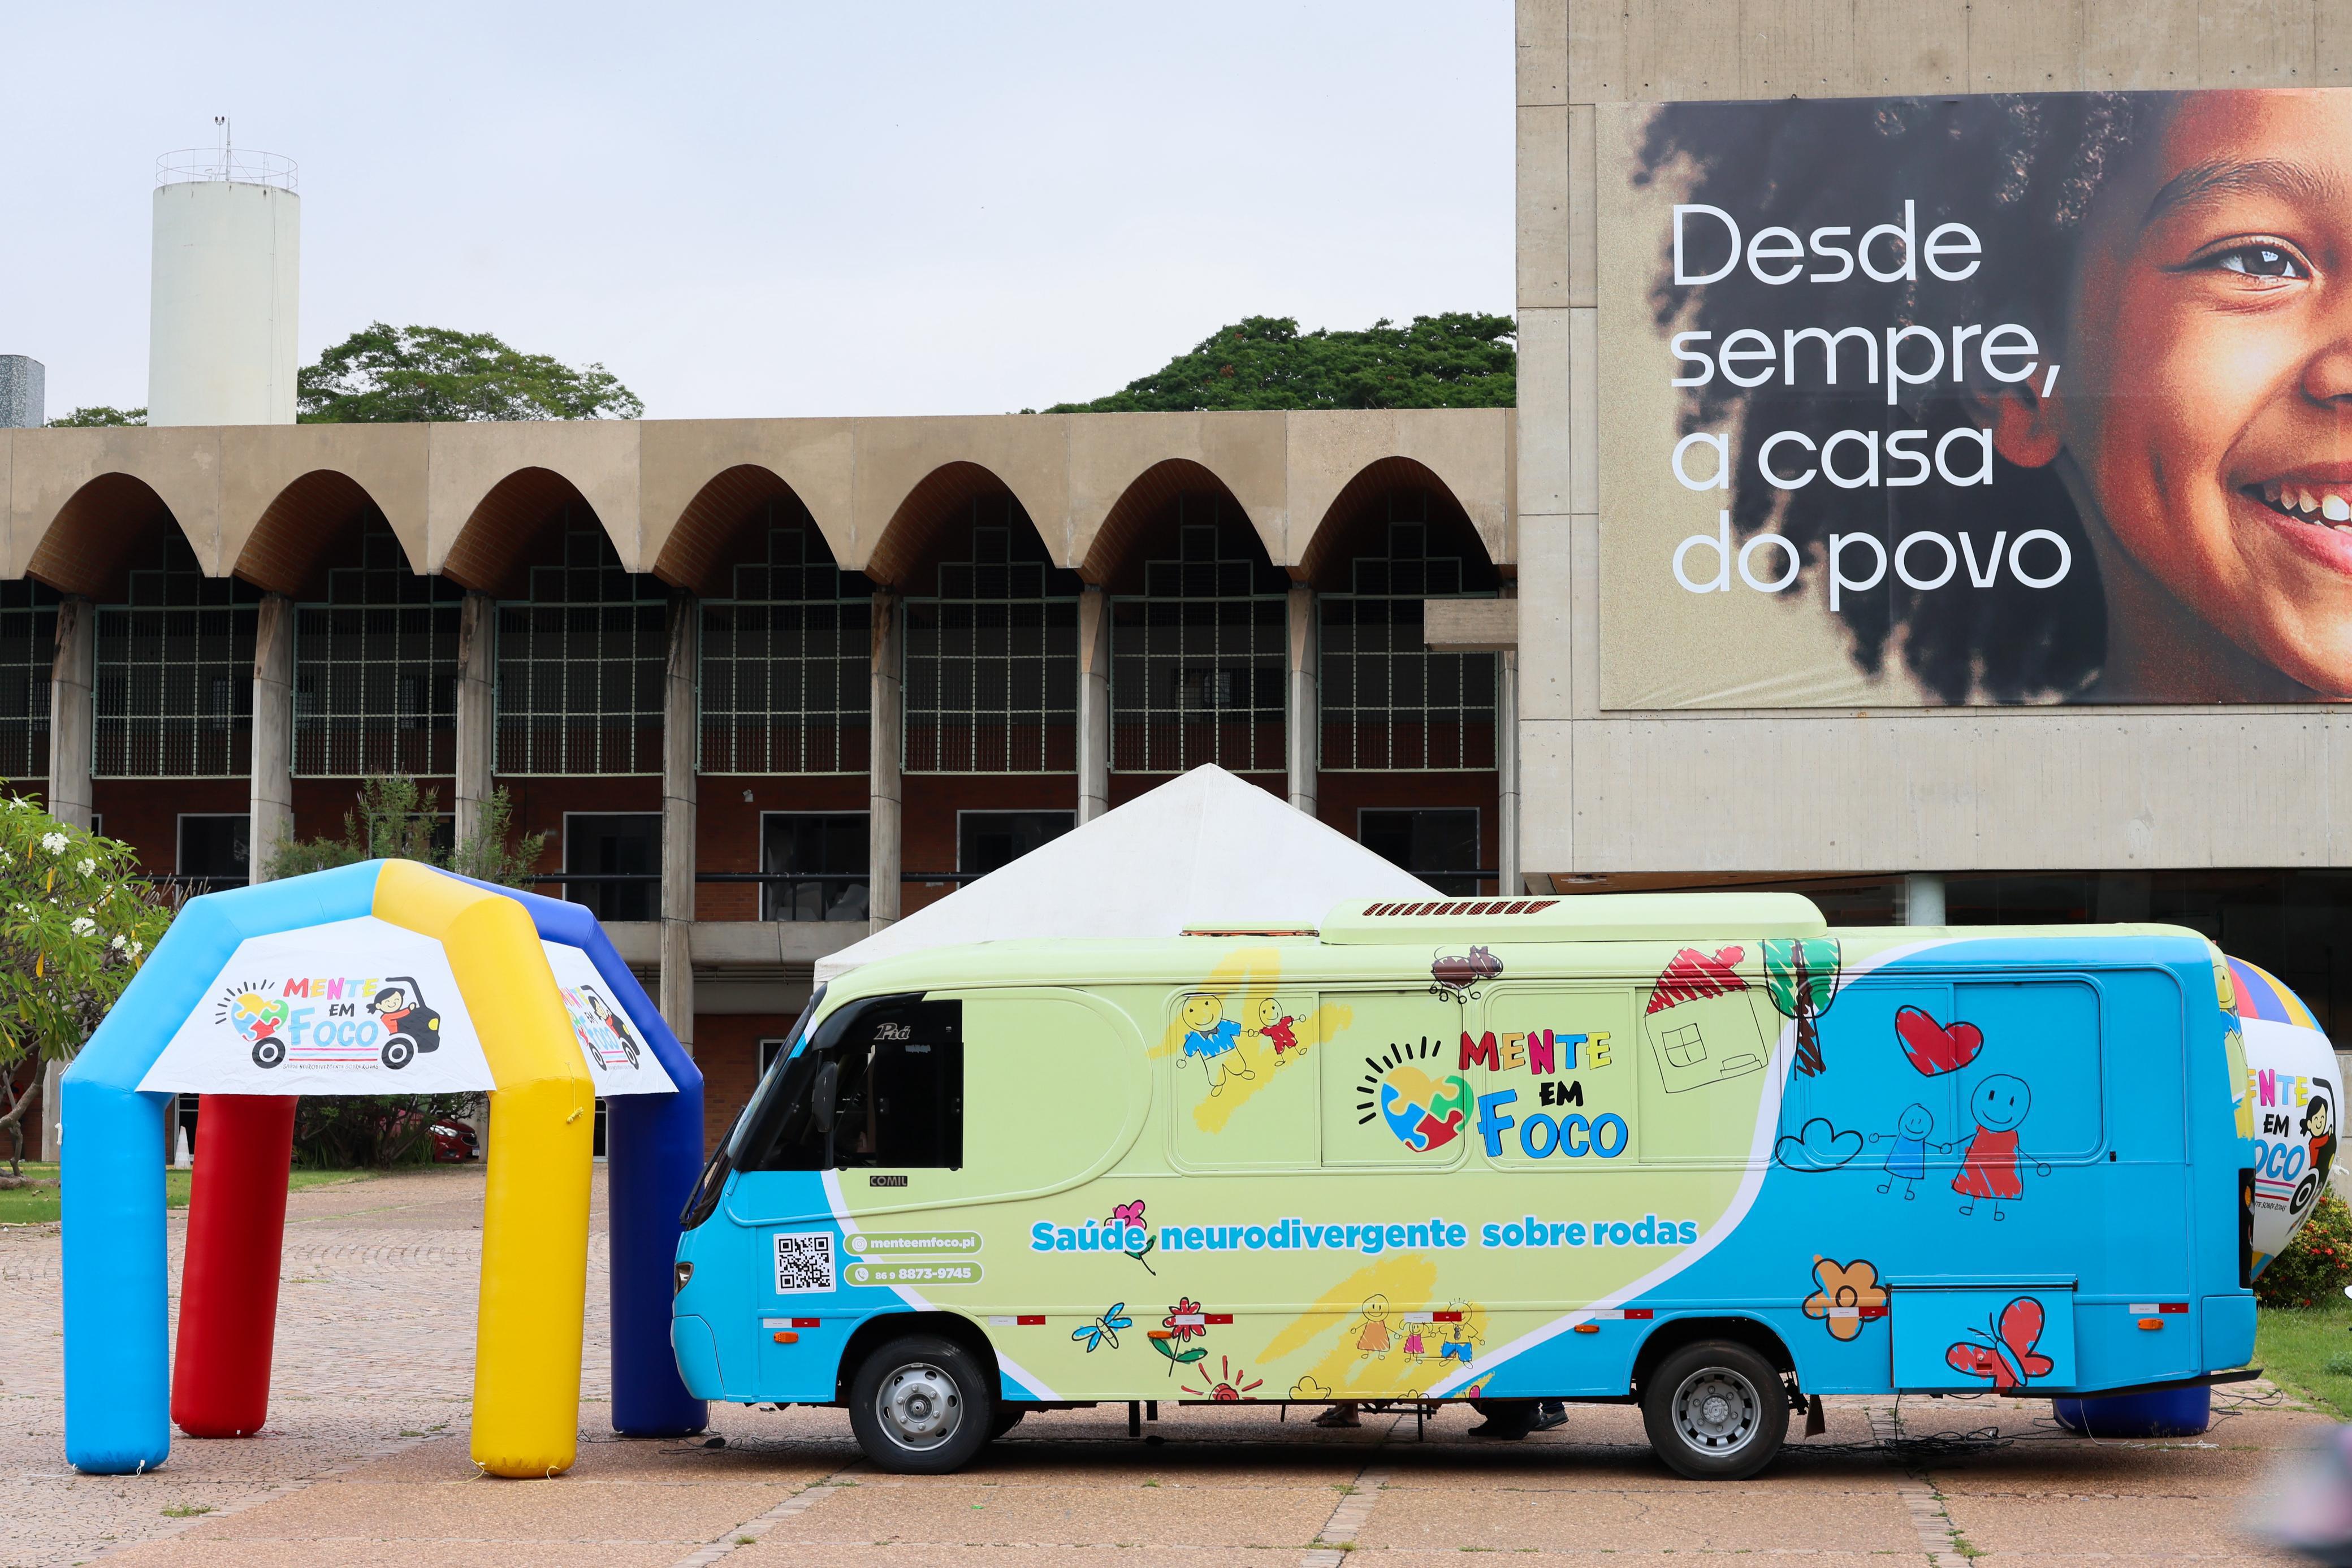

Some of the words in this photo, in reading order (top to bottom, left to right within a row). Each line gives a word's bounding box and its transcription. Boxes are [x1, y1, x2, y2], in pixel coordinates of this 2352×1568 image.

[1673, 199, 1982, 285] Desde
[1670, 323, 2061, 405] sempre,
[1671, 432, 1730, 492] a
[1758, 427, 1994, 491] casa
[1672, 510, 1801, 594] do
[1828, 529, 2072, 612] povo
[283, 977, 379, 1000] MENTE
[288, 1007, 379, 1047] FOCO
[329, 1003, 354, 1017] EM
[1459, 1029, 1612, 1075] MENTE
[1539, 1081, 1584, 1106] EM
[2248, 1069, 2308, 1107] ENTE
[1477, 1089, 1628, 1158] FOCO
[2263, 1114, 2289, 1137] EM
[2255, 1139, 2305, 1181] OCO
[871, 1176, 907, 1186] COMIL
[871, 1237, 975, 1249] menteemfoco.pi
[1031, 1220, 1145, 1251] Saúde
[1161, 1219, 1467, 1254] neurodivergente
[1482, 1216, 1586, 1247] sobre
[1593, 1215, 1697, 1245] rodas
[898, 1267, 971, 1279] 8873-9745
